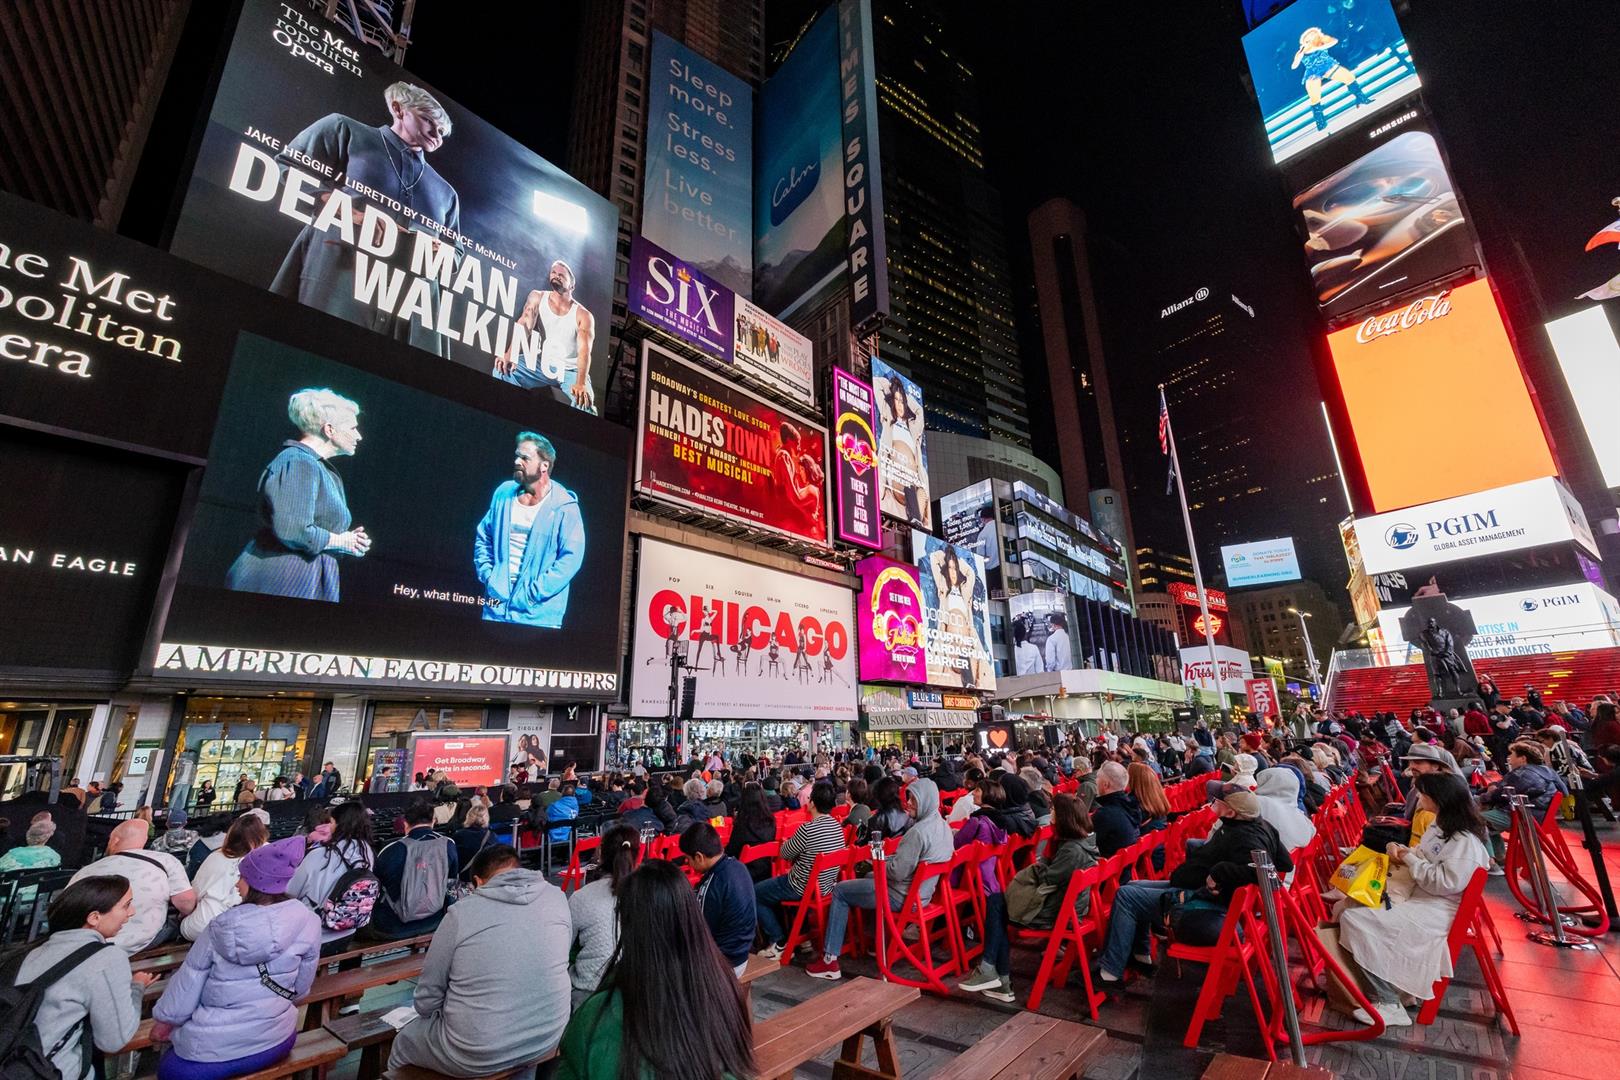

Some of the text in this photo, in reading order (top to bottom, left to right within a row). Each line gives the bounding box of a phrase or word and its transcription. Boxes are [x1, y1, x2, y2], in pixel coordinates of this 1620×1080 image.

[272, 29, 335, 75] Opera
[275, 18, 363, 79] ropolitan
[280, 2, 360, 62] The Met
[670, 59, 733, 108] Sleep
[841, 5, 860, 125] TIMES
[669, 83, 734, 130] more.
[1369, 109, 1419, 140] SAMSUNG
[667, 133, 717, 175] less.
[668, 112, 736, 162] Stress
[244, 126, 281, 150] JAKE
[283, 145, 334, 177] HEGGIE
[345, 176, 401, 212] LIBRETTO
[403, 206, 418, 219] BY
[420, 213, 473, 249] TERRENCE
[475, 243, 518, 270] McNALLY
[665, 168, 713, 206] Live
[772, 160, 819, 208] Calm
[228, 141, 519, 318] DEAD MAN
[663, 191, 742, 245] better.
[846, 136, 869, 304] SQUARE
[60, 255, 177, 322] Met
[646, 256, 724, 336] SIX
[1160, 295, 1195, 319] Allianz
[354, 251, 566, 383] WALKING
[1355, 288, 1453, 345] Coca-Cola
[0, 333, 92, 378] era
[650, 370, 771, 432] BROADWAY'S GREATEST LOVE STORY
[649, 388, 771, 468] HADESTOWN
[649, 422, 681, 443] WINNER!
[690, 439, 707, 453] TONY
[673, 443, 754, 485] BEST MUSICAL
[1426, 508, 1501, 541] PGIM
[1433, 527, 1526, 552] GLOBAL ASSET MANAGEMENT
[51, 553, 137, 576] EAGLE
[668, 576, 681, 584] POP
[393, 583, 501, 609] Hey, what time is it?
[734, 589, 753, 598] SQUISH
[1542, 594, 1581, 609] PGIM
[648, 588, 848, 661] CHICAGO
[925, 627, 978, 647] KOURTNEY
[1495, 635, 1516, 646] AND
[1508, 621, 1519, 631] IN
[164, 645, 617, 691] AMERICAN EAGLE OUTFITTERS
[926, 640, 991, 661] KARDASHIAN
[926, 654, 970, 670] BARKER
[1502, 642, 1552, 656] MARKETS
[912, 691, 942, 702] BLUE FIN
[700, 723, 793, 738] GRAND SLAM
[870, 711, 976, 726] SWAROVSKI SWAROVSKI
[133, 756, 148, 764] 50
[979, 731, 990, 750] I
[461, 764, 492, 772] seconds.
